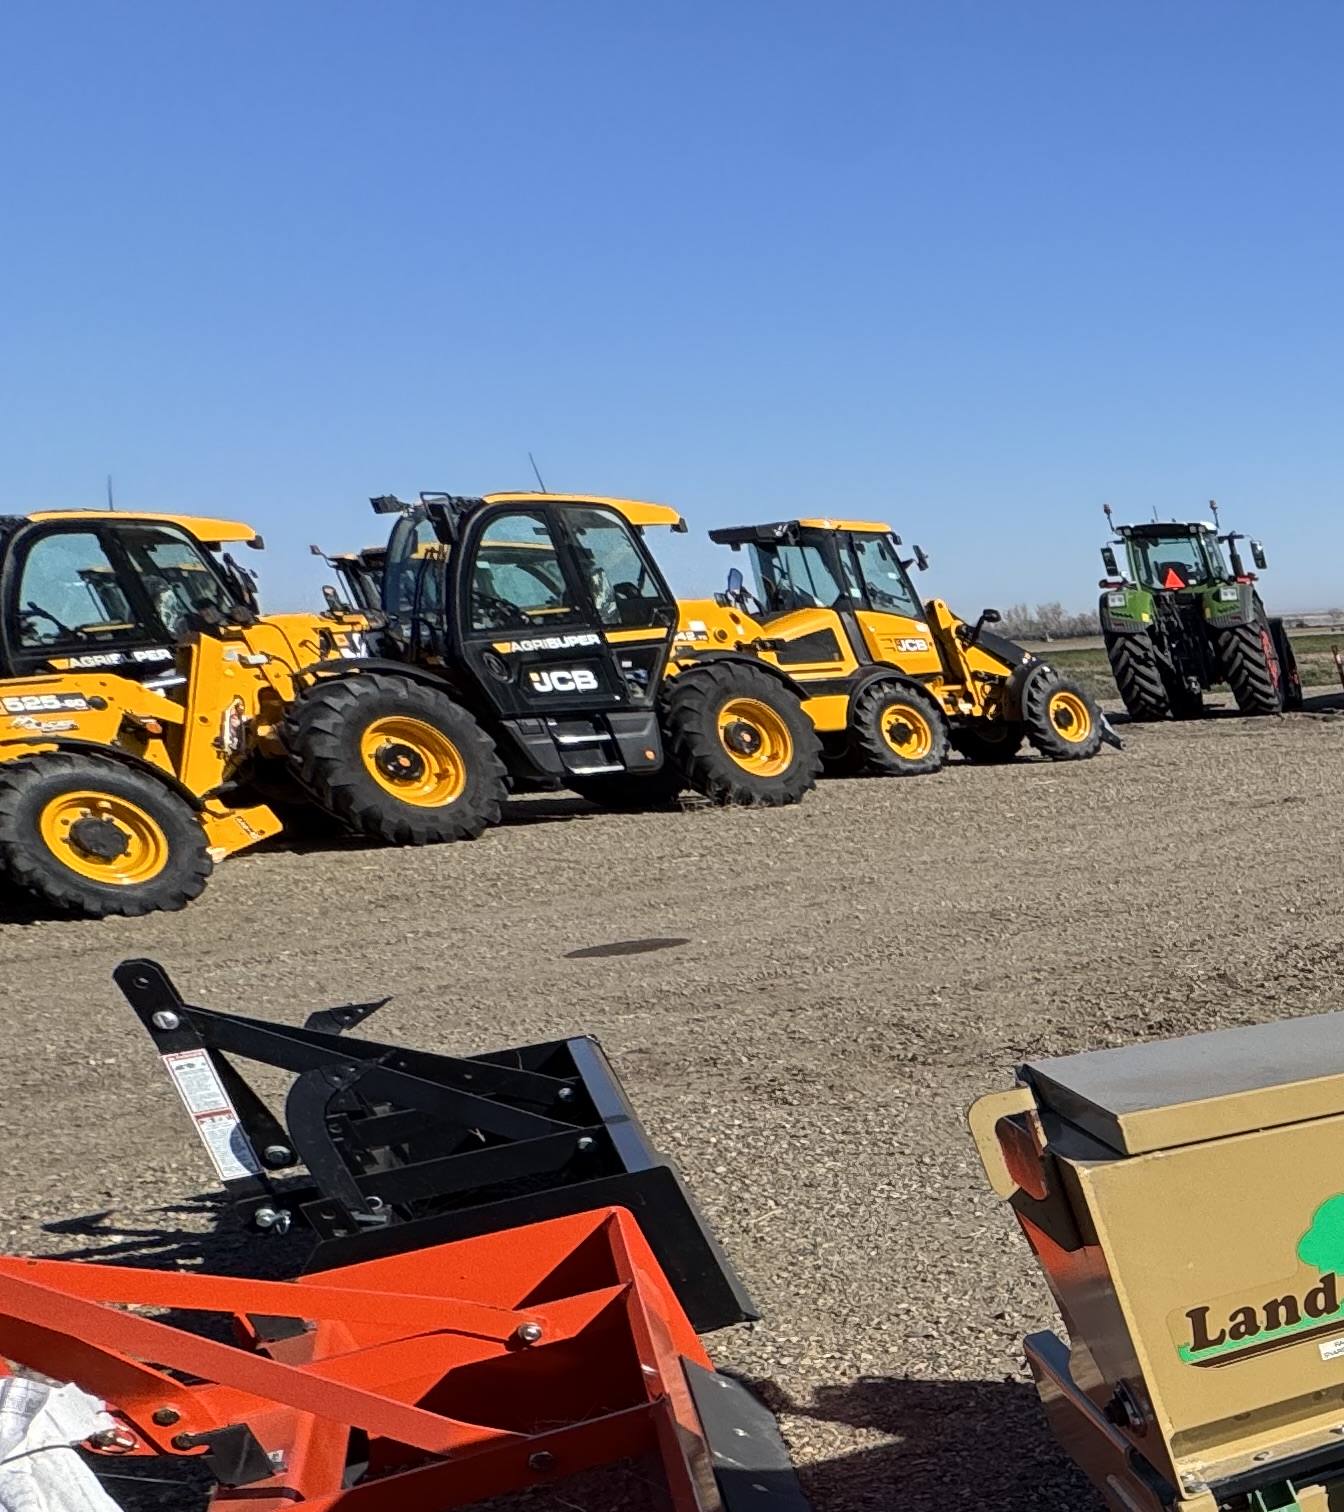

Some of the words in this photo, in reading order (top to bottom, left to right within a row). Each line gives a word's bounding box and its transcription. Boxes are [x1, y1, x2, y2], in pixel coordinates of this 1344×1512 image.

[509, 633, 601, 652] AGRISUPER
[895, 639, 929, 651] JCB
[529, 670, 598, 693] JCB
[1185, 1272, 1341, 1353] Land
